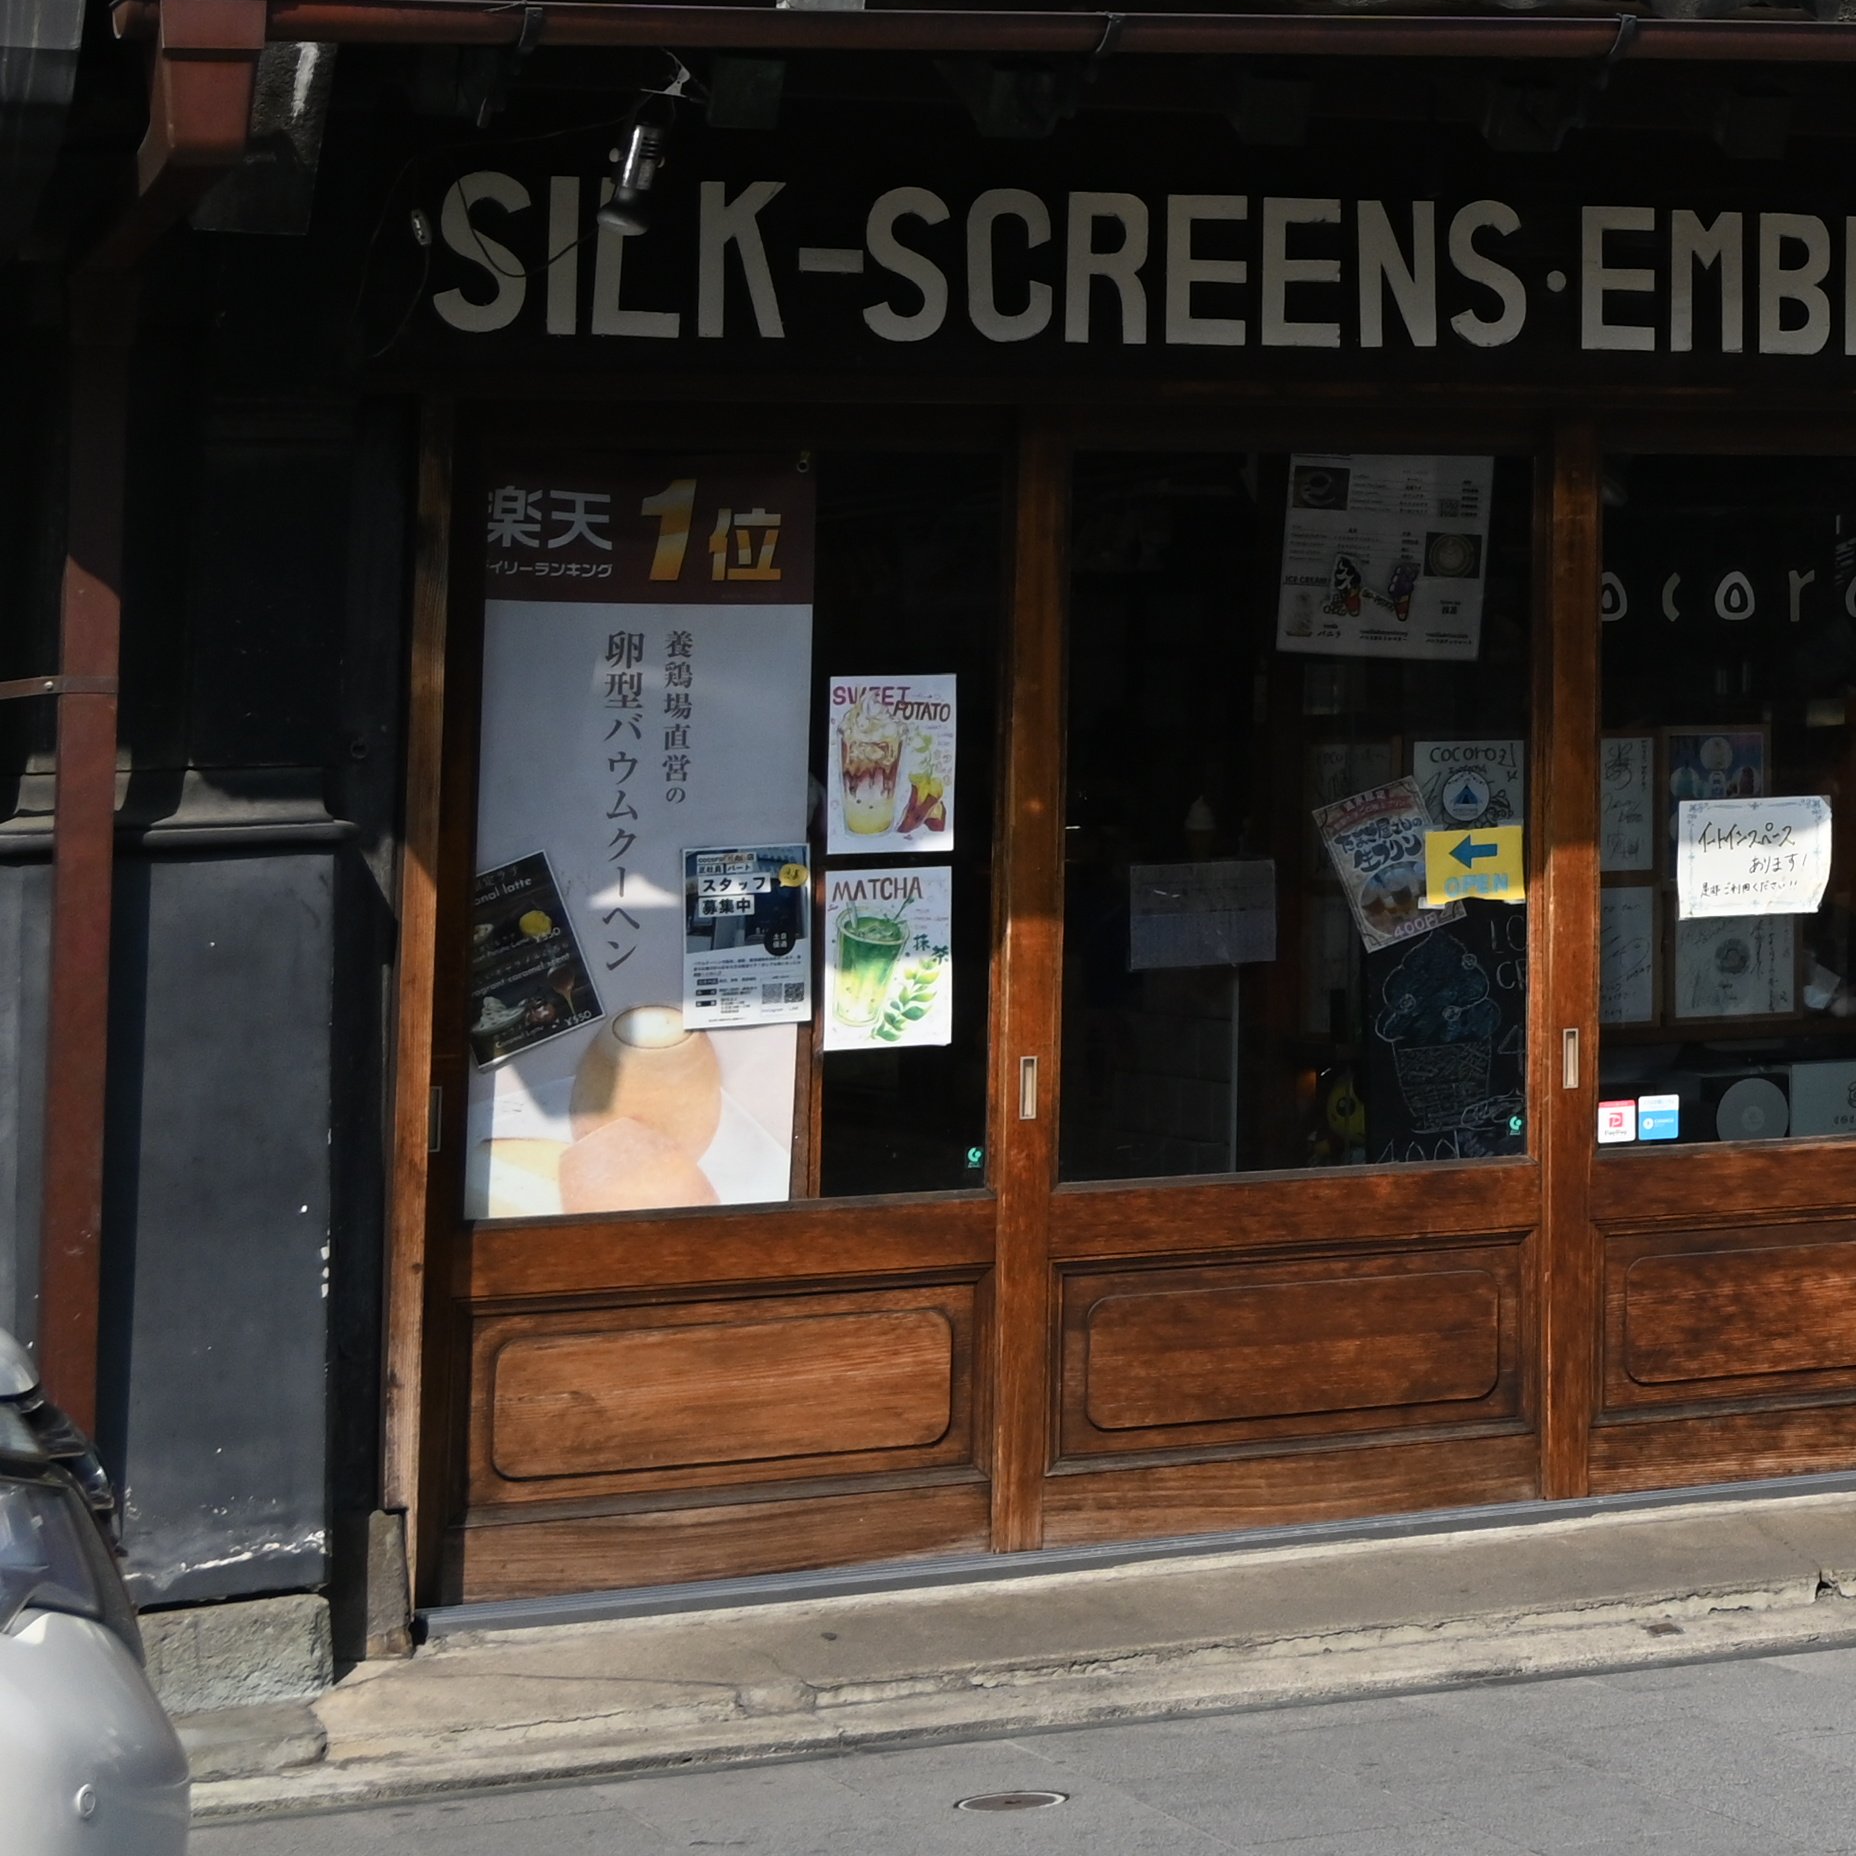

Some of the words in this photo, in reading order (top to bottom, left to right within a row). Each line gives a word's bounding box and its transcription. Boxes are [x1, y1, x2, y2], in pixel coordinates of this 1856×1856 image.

[487, 485, 613, 551] 楽天
[661, 630, 694, 804] 養鶏場直営の
[892, 700, 951, 723] POTATO
[602, 629, 645, 973] 卵型バウムクーヘン
[1697, 821, 1796, 853] イートインスペース
[702, 876, 766, 893] スタッフ
[832, 876, 923, 902] MATCHA
[1444, 873, 1509, 898] OPEN
[702, 897, 751, 916] 募集中
